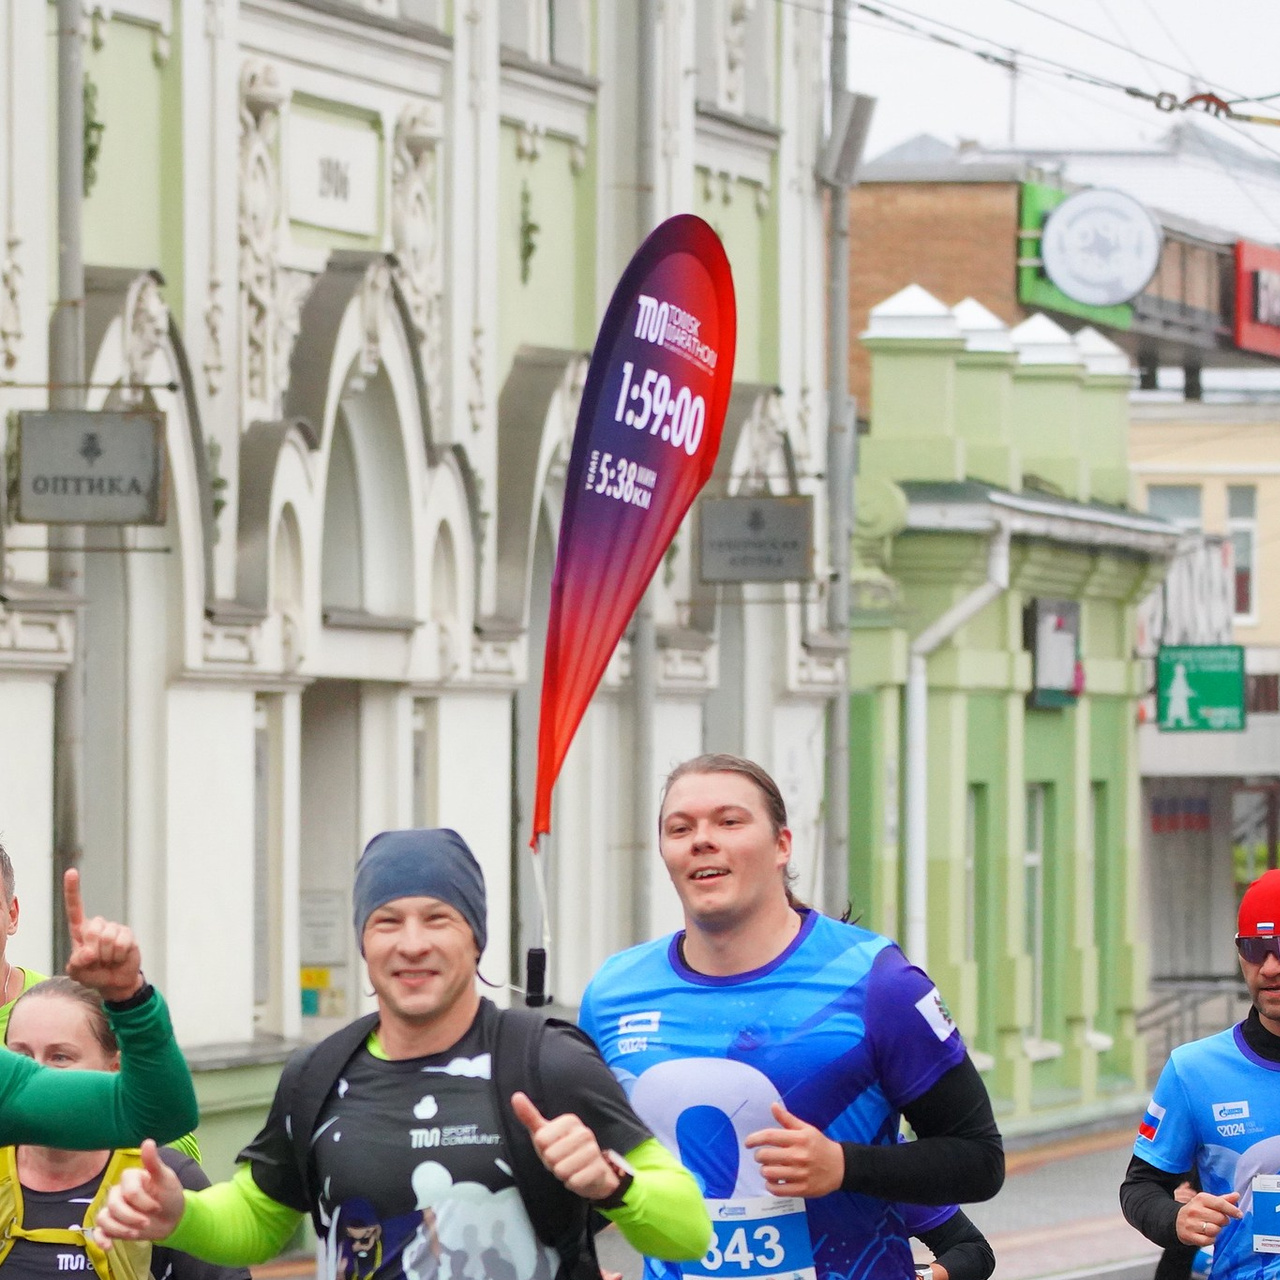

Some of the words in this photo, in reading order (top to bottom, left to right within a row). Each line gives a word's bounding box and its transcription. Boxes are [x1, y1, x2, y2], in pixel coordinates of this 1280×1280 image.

[615, 361, 705, 456] 1:59:00
[32, 474, 143, 496] ОПТИКА
[595, 452, 638, 503] 5:38
